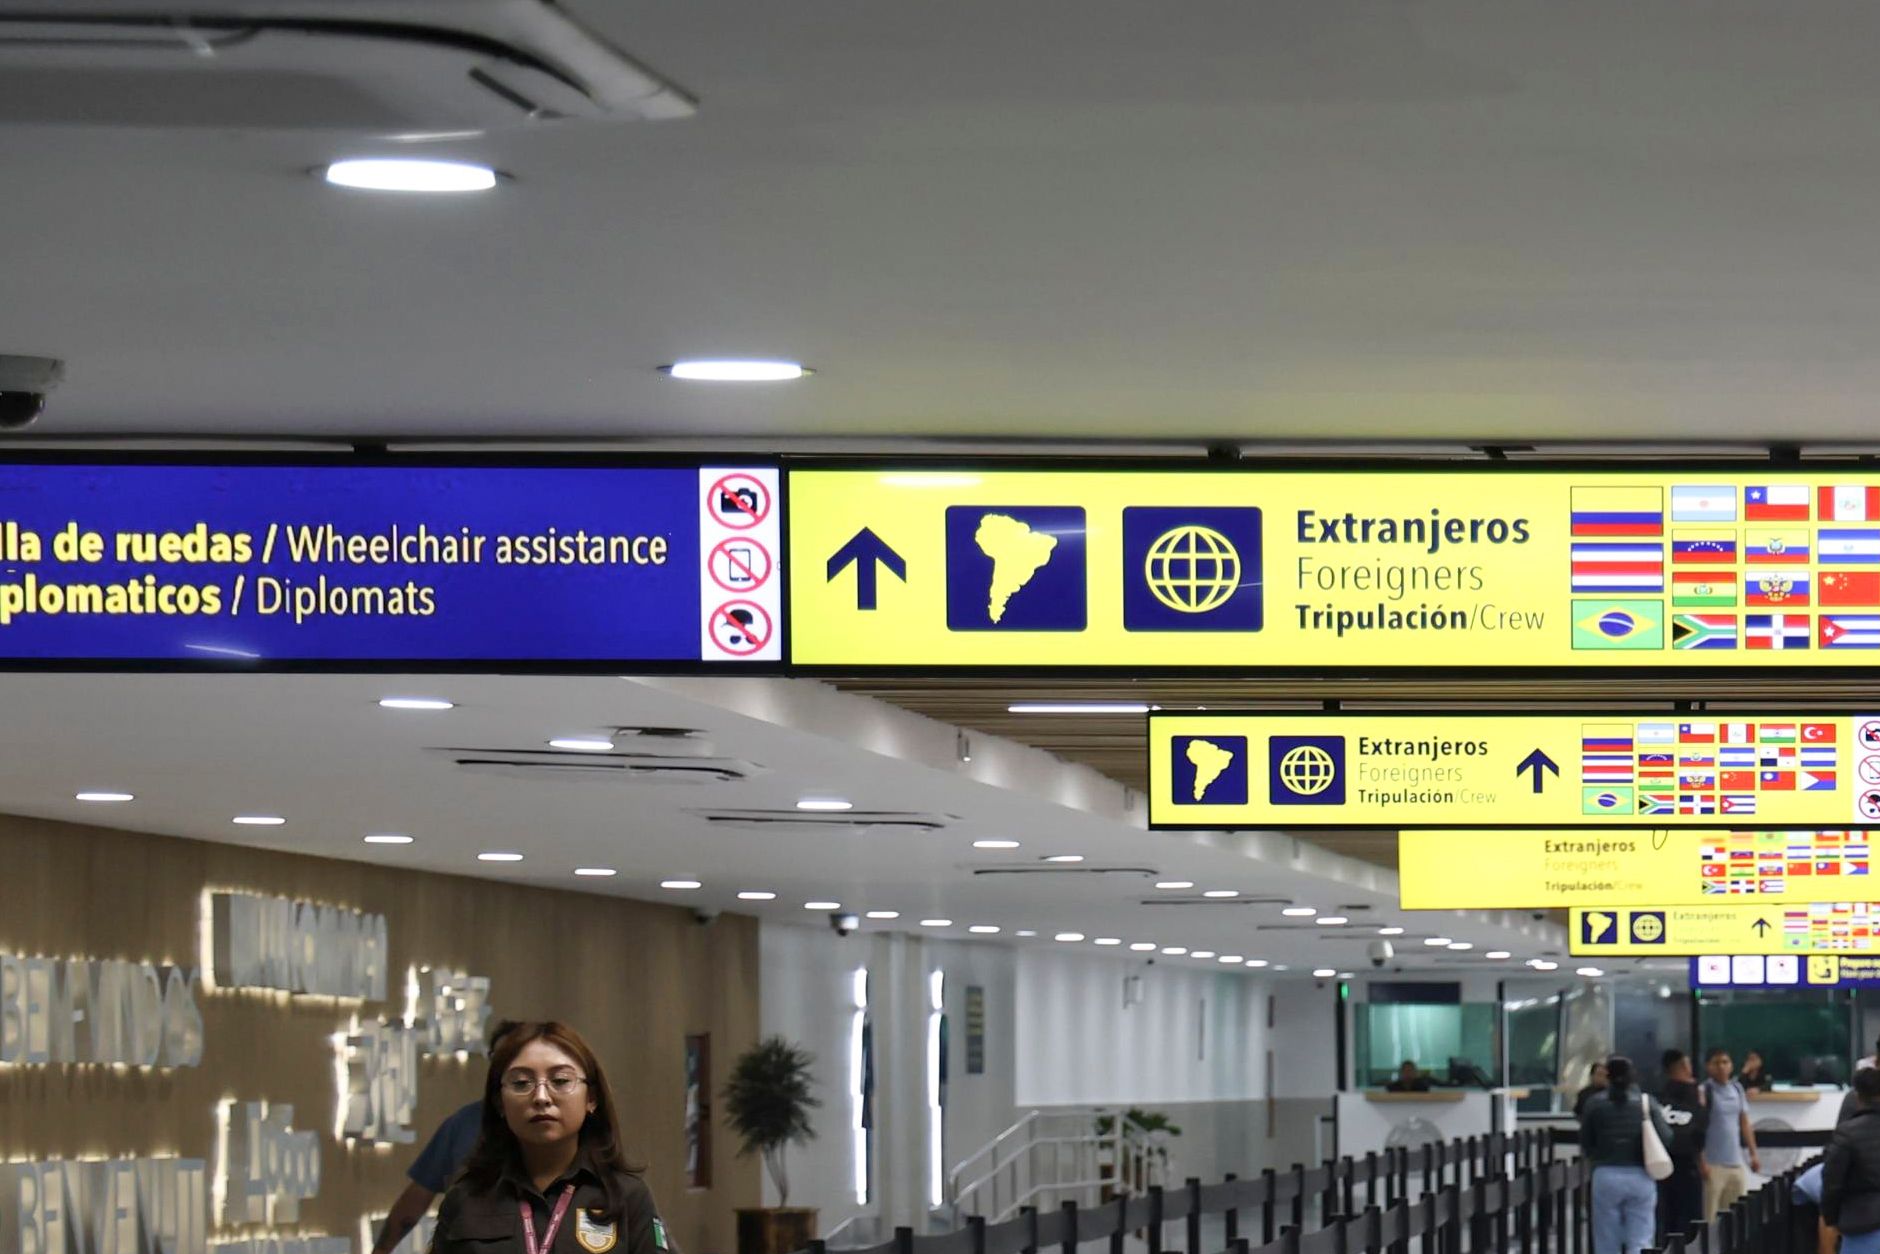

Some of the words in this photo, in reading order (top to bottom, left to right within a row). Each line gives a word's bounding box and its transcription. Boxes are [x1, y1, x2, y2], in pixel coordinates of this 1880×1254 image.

[0, 521, 41, 562] la
[53, 522, 104, 562] de
[116, 522, 252, 563] ruedas
[286, 523, 486, 564] Wheelchair
[496, 527, 667, 564] assistance
[1297, 508, 1530, 555] Extranjeros
[257, 575, 436, 624] Diplomats
[1299, 556, 1484, 601] Foreigners
[1358, 735, 1489, 762] Extranjeros
[1359, 762, 1463, 788] Foreigners
[1544, 838, 1636, 857] Extranjeros
